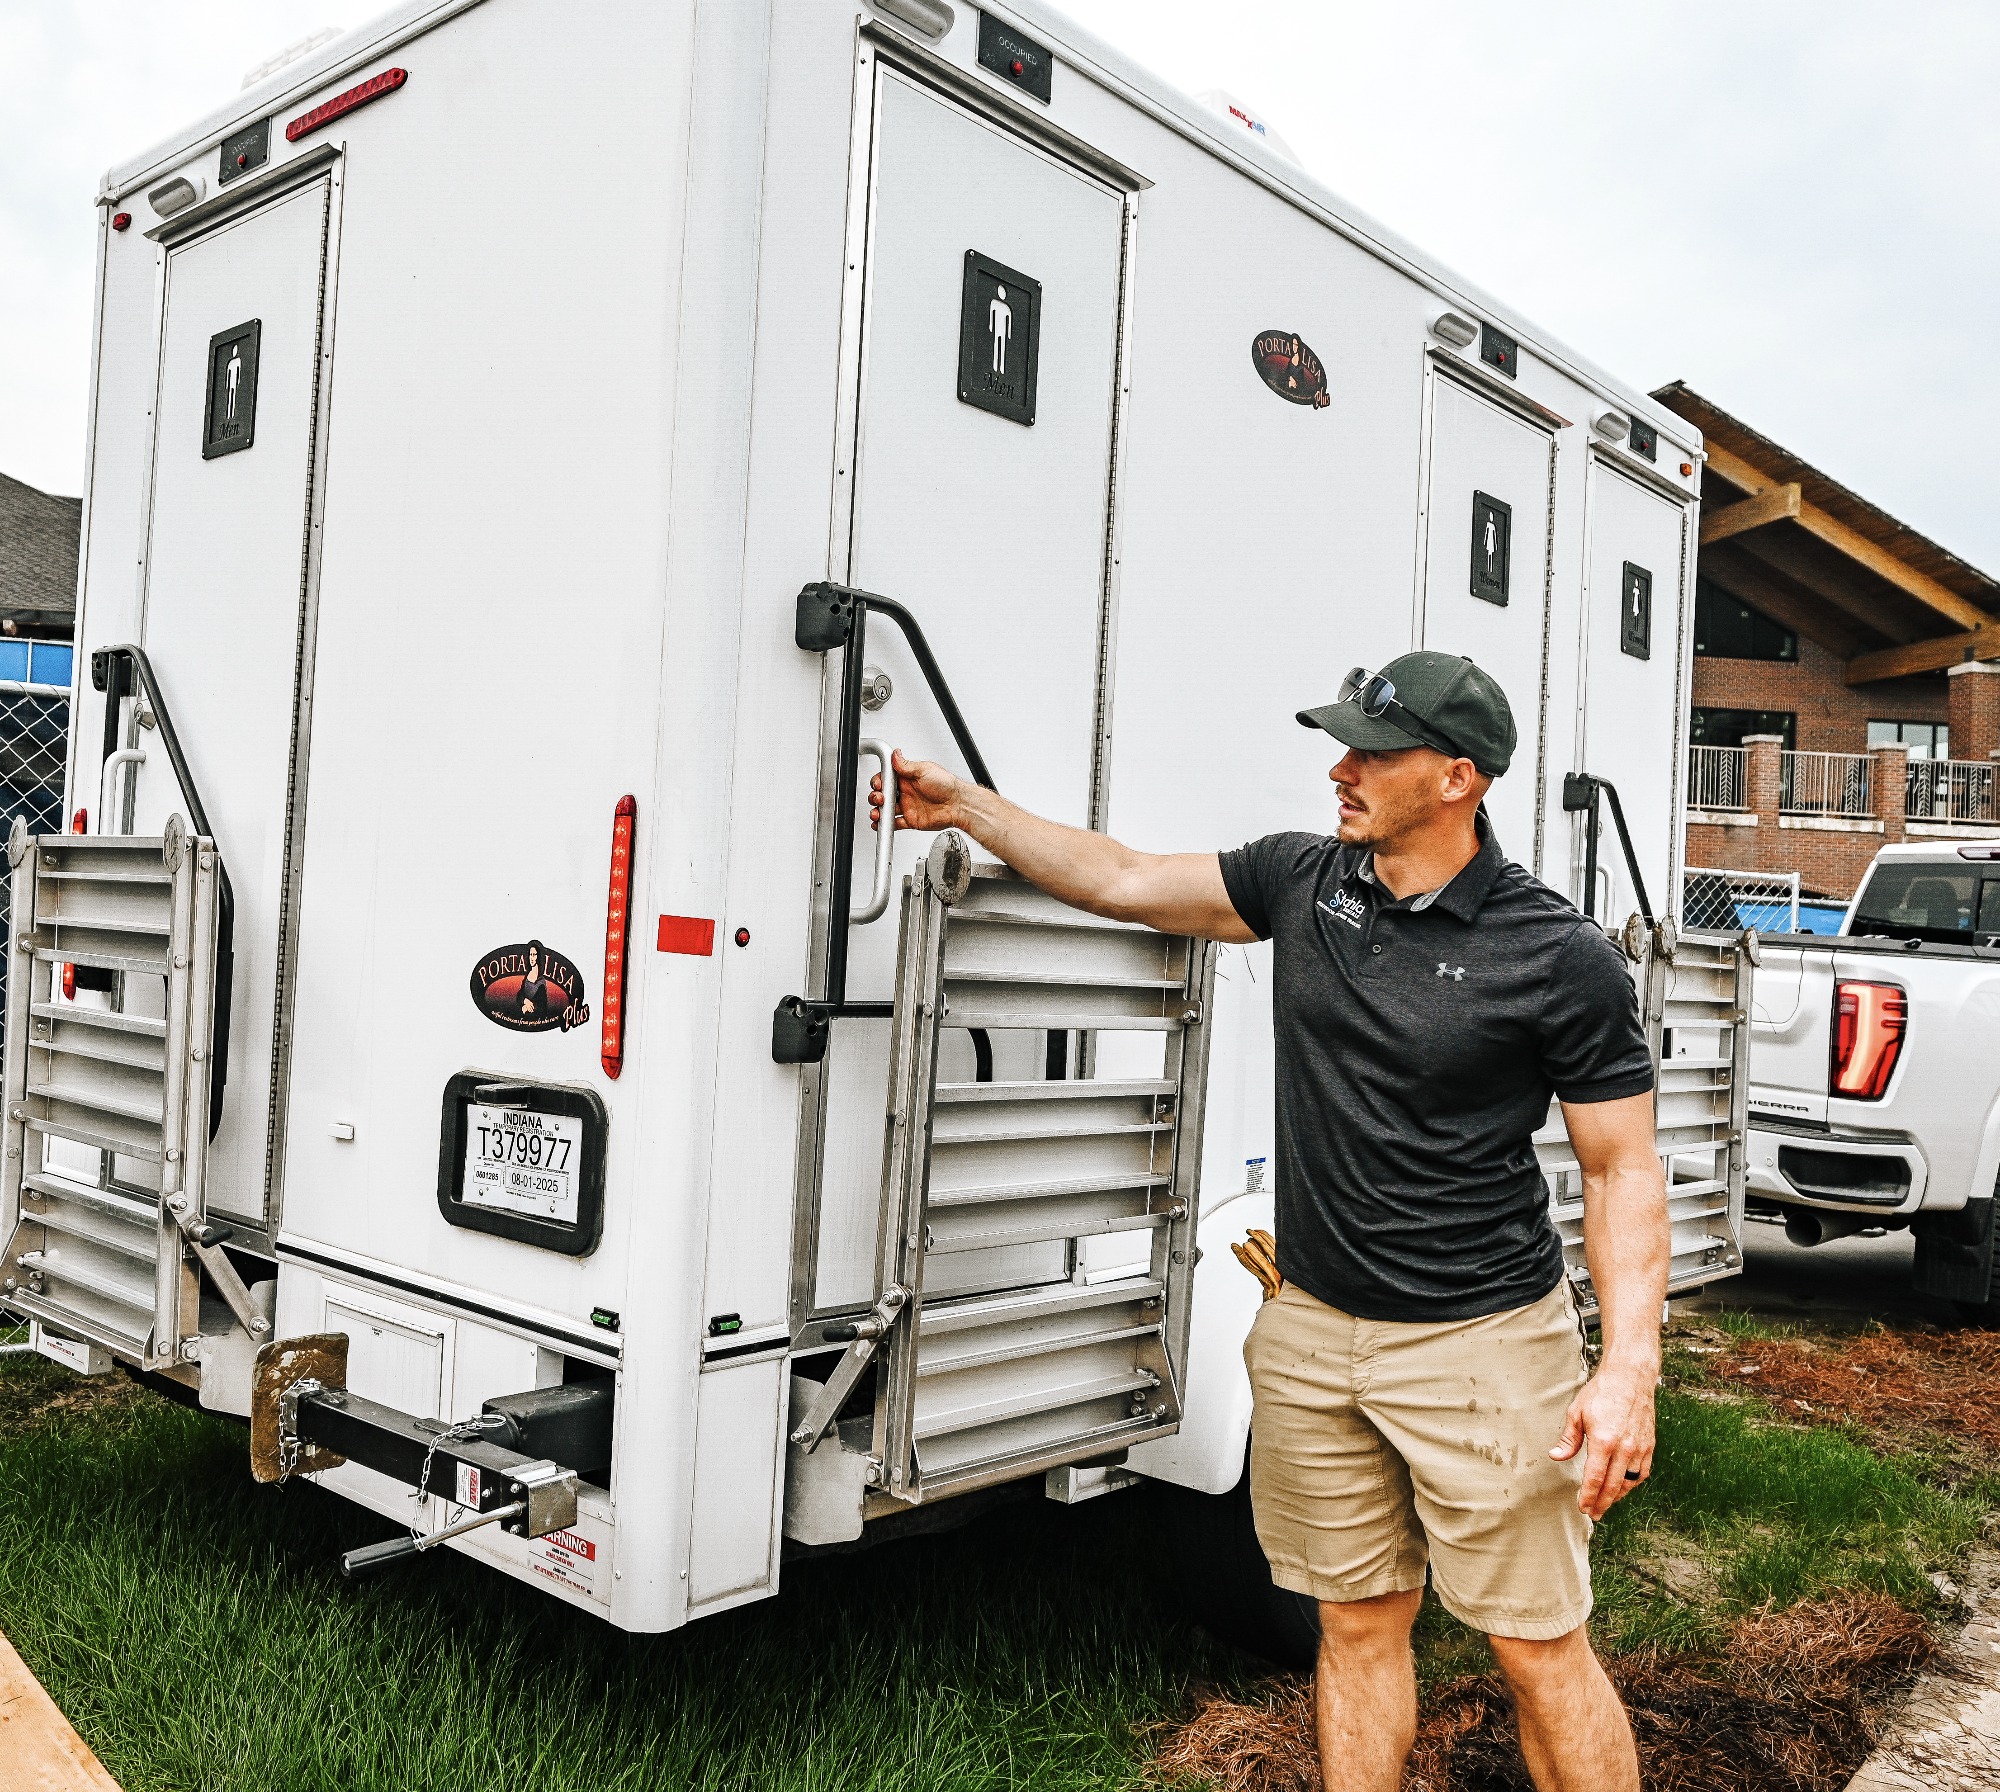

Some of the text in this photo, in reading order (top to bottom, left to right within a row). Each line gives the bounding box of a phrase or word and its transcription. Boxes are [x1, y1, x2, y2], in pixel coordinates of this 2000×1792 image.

[998, 36, 1037, 65] OCCUPIED
[1257, 338, 1321, 382] PORTA LISA
[982, 372, 1014, 400] Men
[1314, 386, 1330, 407] Plus
[219, 421, 240, 441] Men
[1329, 888, 1365, 915] Stahla
[478, 954, 575, 995] PORTA LISA
[563, 998, 589, 1029] Plus
[493, 1123, 554, 1137] TEMPORARY REGISTRATION
[503, 1112, 543, 1129] INDIANA
[477, 1126, 572, 1170] T379977
[511, 1172, 559, 1193] 08-01-2025
[543, 1530, 588, 1556] ARNING
